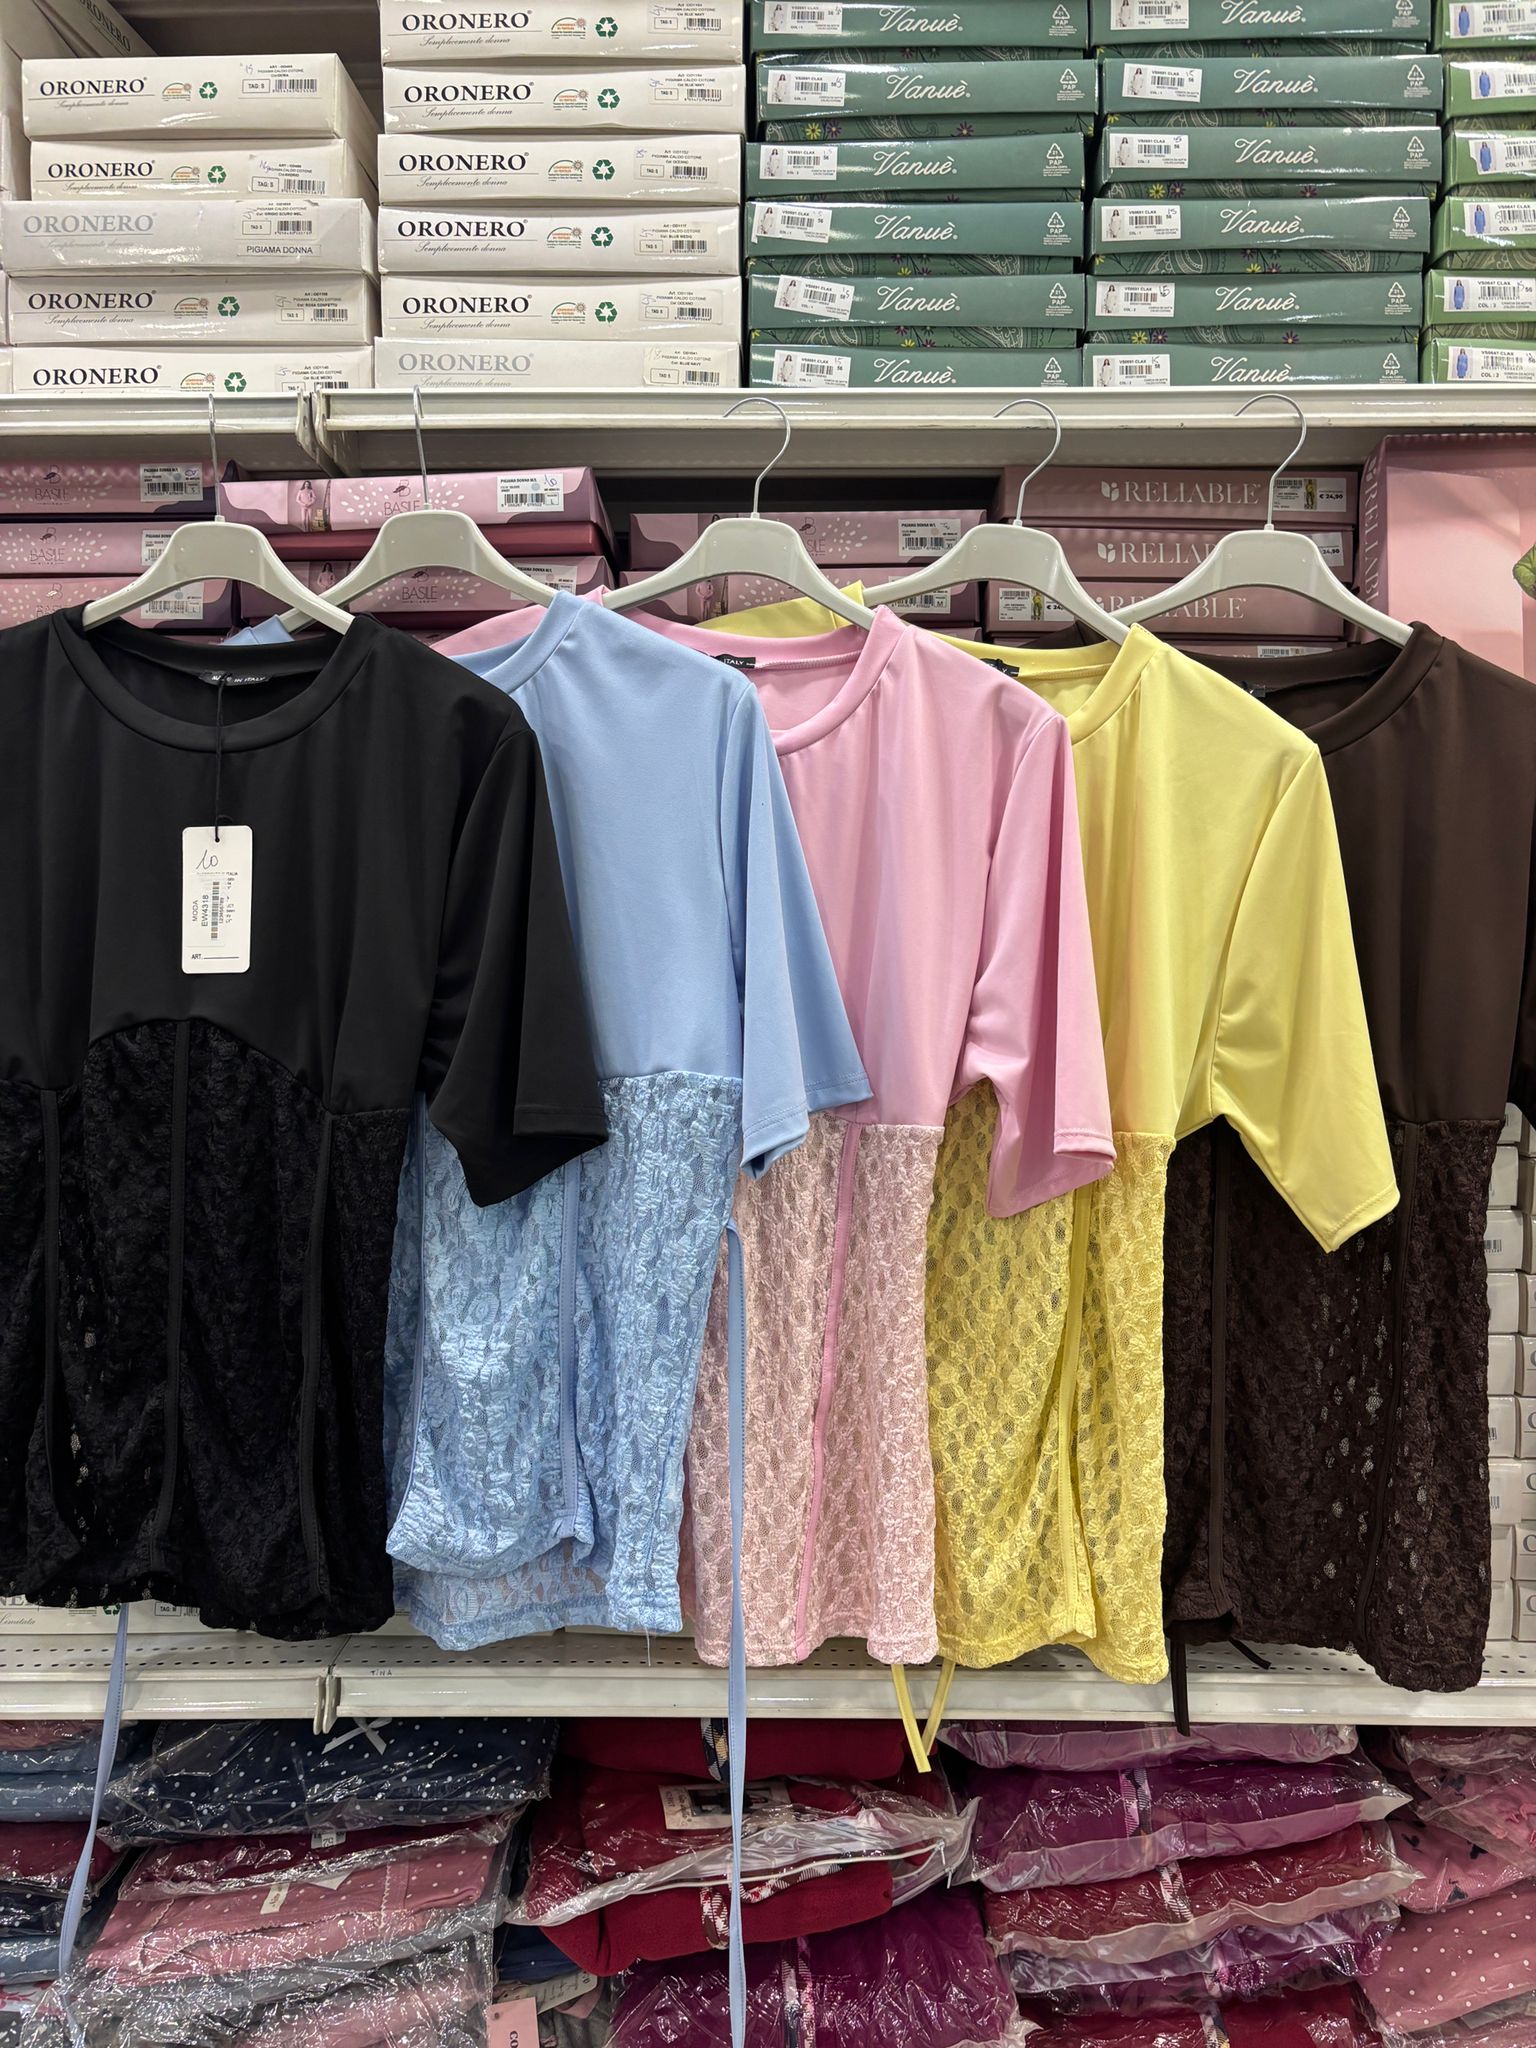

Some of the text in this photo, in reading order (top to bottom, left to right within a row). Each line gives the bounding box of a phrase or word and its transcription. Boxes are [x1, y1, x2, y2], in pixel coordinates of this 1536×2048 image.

[879, 8, 960, 32] Vanuè
[1221, 0, 1303, 24] Vanuè
[402, 13, 529, 31] ORONERO
[485, 36, 511, 45] donna
[40, 79, 145, 97] ORONERO
[886, 74, 967, 99] Vanuè
[1234, 69, 1315, 93] Vanuè
[404, 84, 531, 102] ORONERO
[487, 108, 513, 116] donna
[1235, 138, 1315, 164] Vanuè
[48, 162, 153, 180] ORONERO
[399, 154, 526, 172] ORONERO
[873, 151, 954, 176] Vanuè
[482, 178, 508, 186] donna
[23, 214, 154, 234] ORONERO
[398, 220, 525, 238] ORONERO
[874, 215, 955, 239] Vanuè
[1220, 209, 1302, 234] Vanuè
[283, 246, 314, 254] DONNA
[481, 243, 507, 252] donna
[28, 292, 153, 310] ORONERO
[402, 296, 529, 314] ORONERO
[877, 286, 958, 311] Vanuè
[1216, 287, 1297, 311] Vanuè
[485, 320, 511, 328] donna
[398, 353, 531, 372] ORONERO
[873, 358, 954, 384] Vanuè
[33, 367, 159, 386] ORONERO
[1124, 481, 1257, 505] RELIABLE
